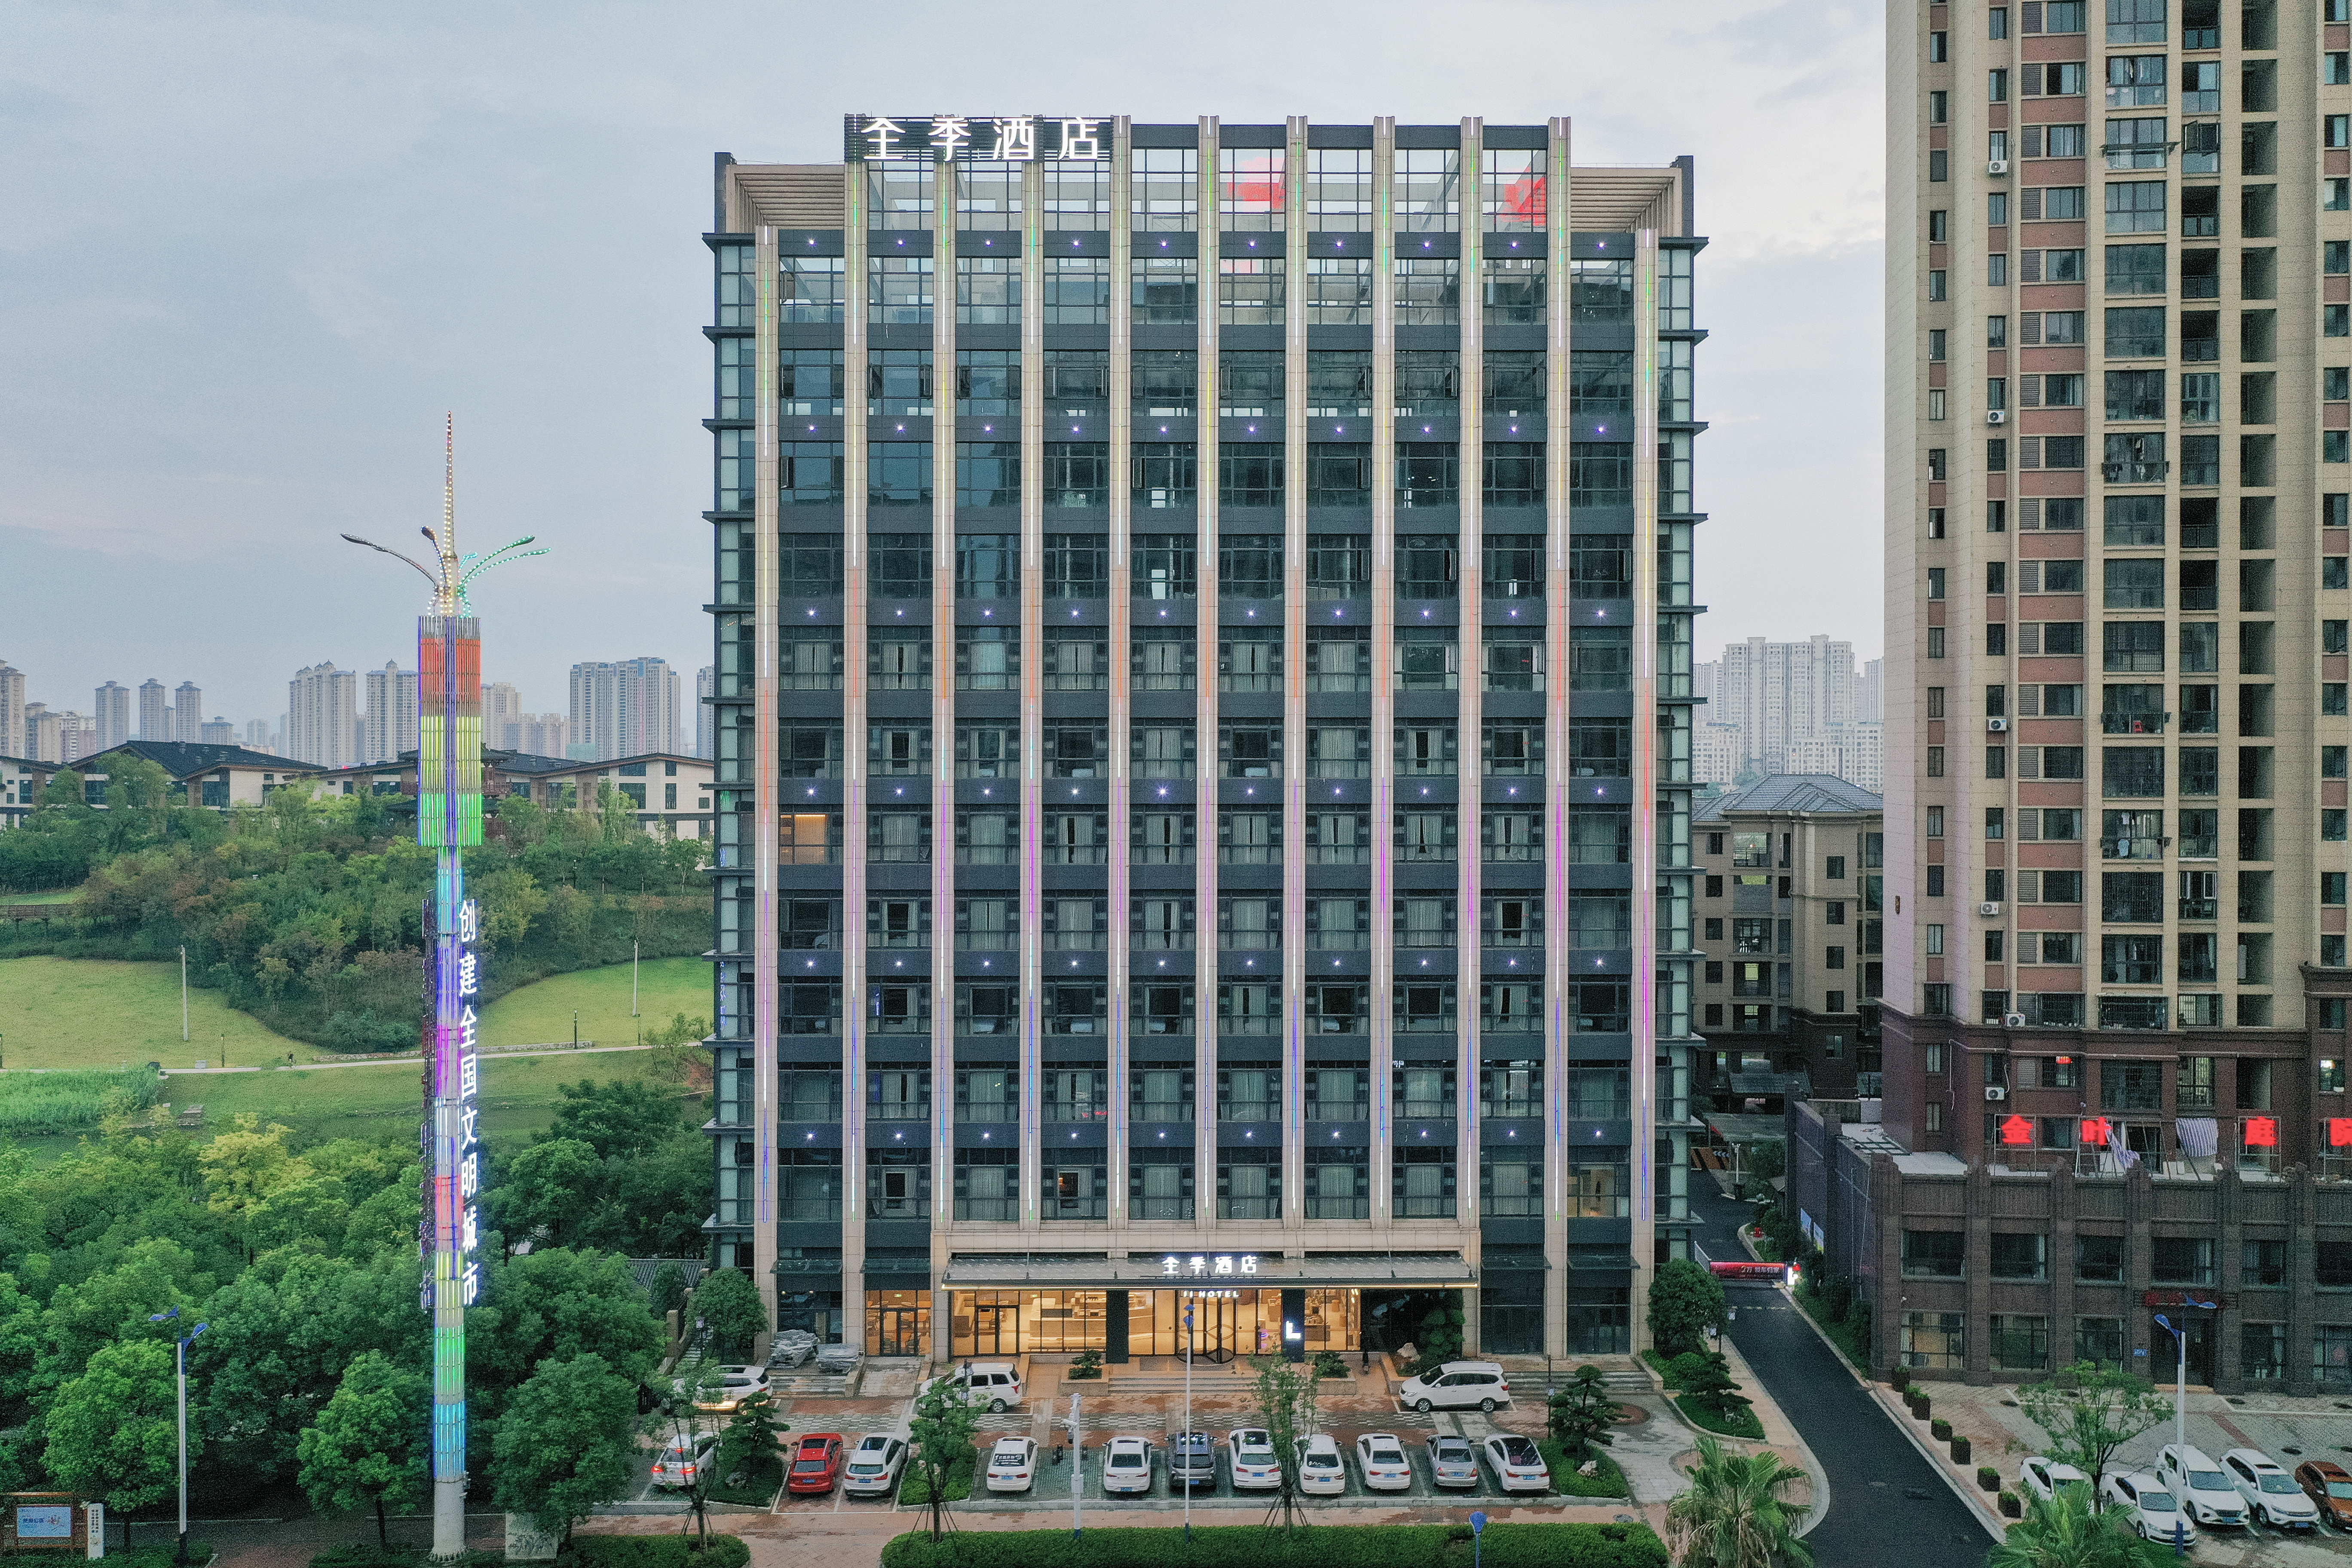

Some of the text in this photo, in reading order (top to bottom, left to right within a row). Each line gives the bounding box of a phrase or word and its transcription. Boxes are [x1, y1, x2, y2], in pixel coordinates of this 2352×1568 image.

[861, 117, 1099, 162] 全季酒店
[459, 898, 478, 1305] 创建全国文明城市
[1162, 1256, 1257, 1274] 全季酒店
